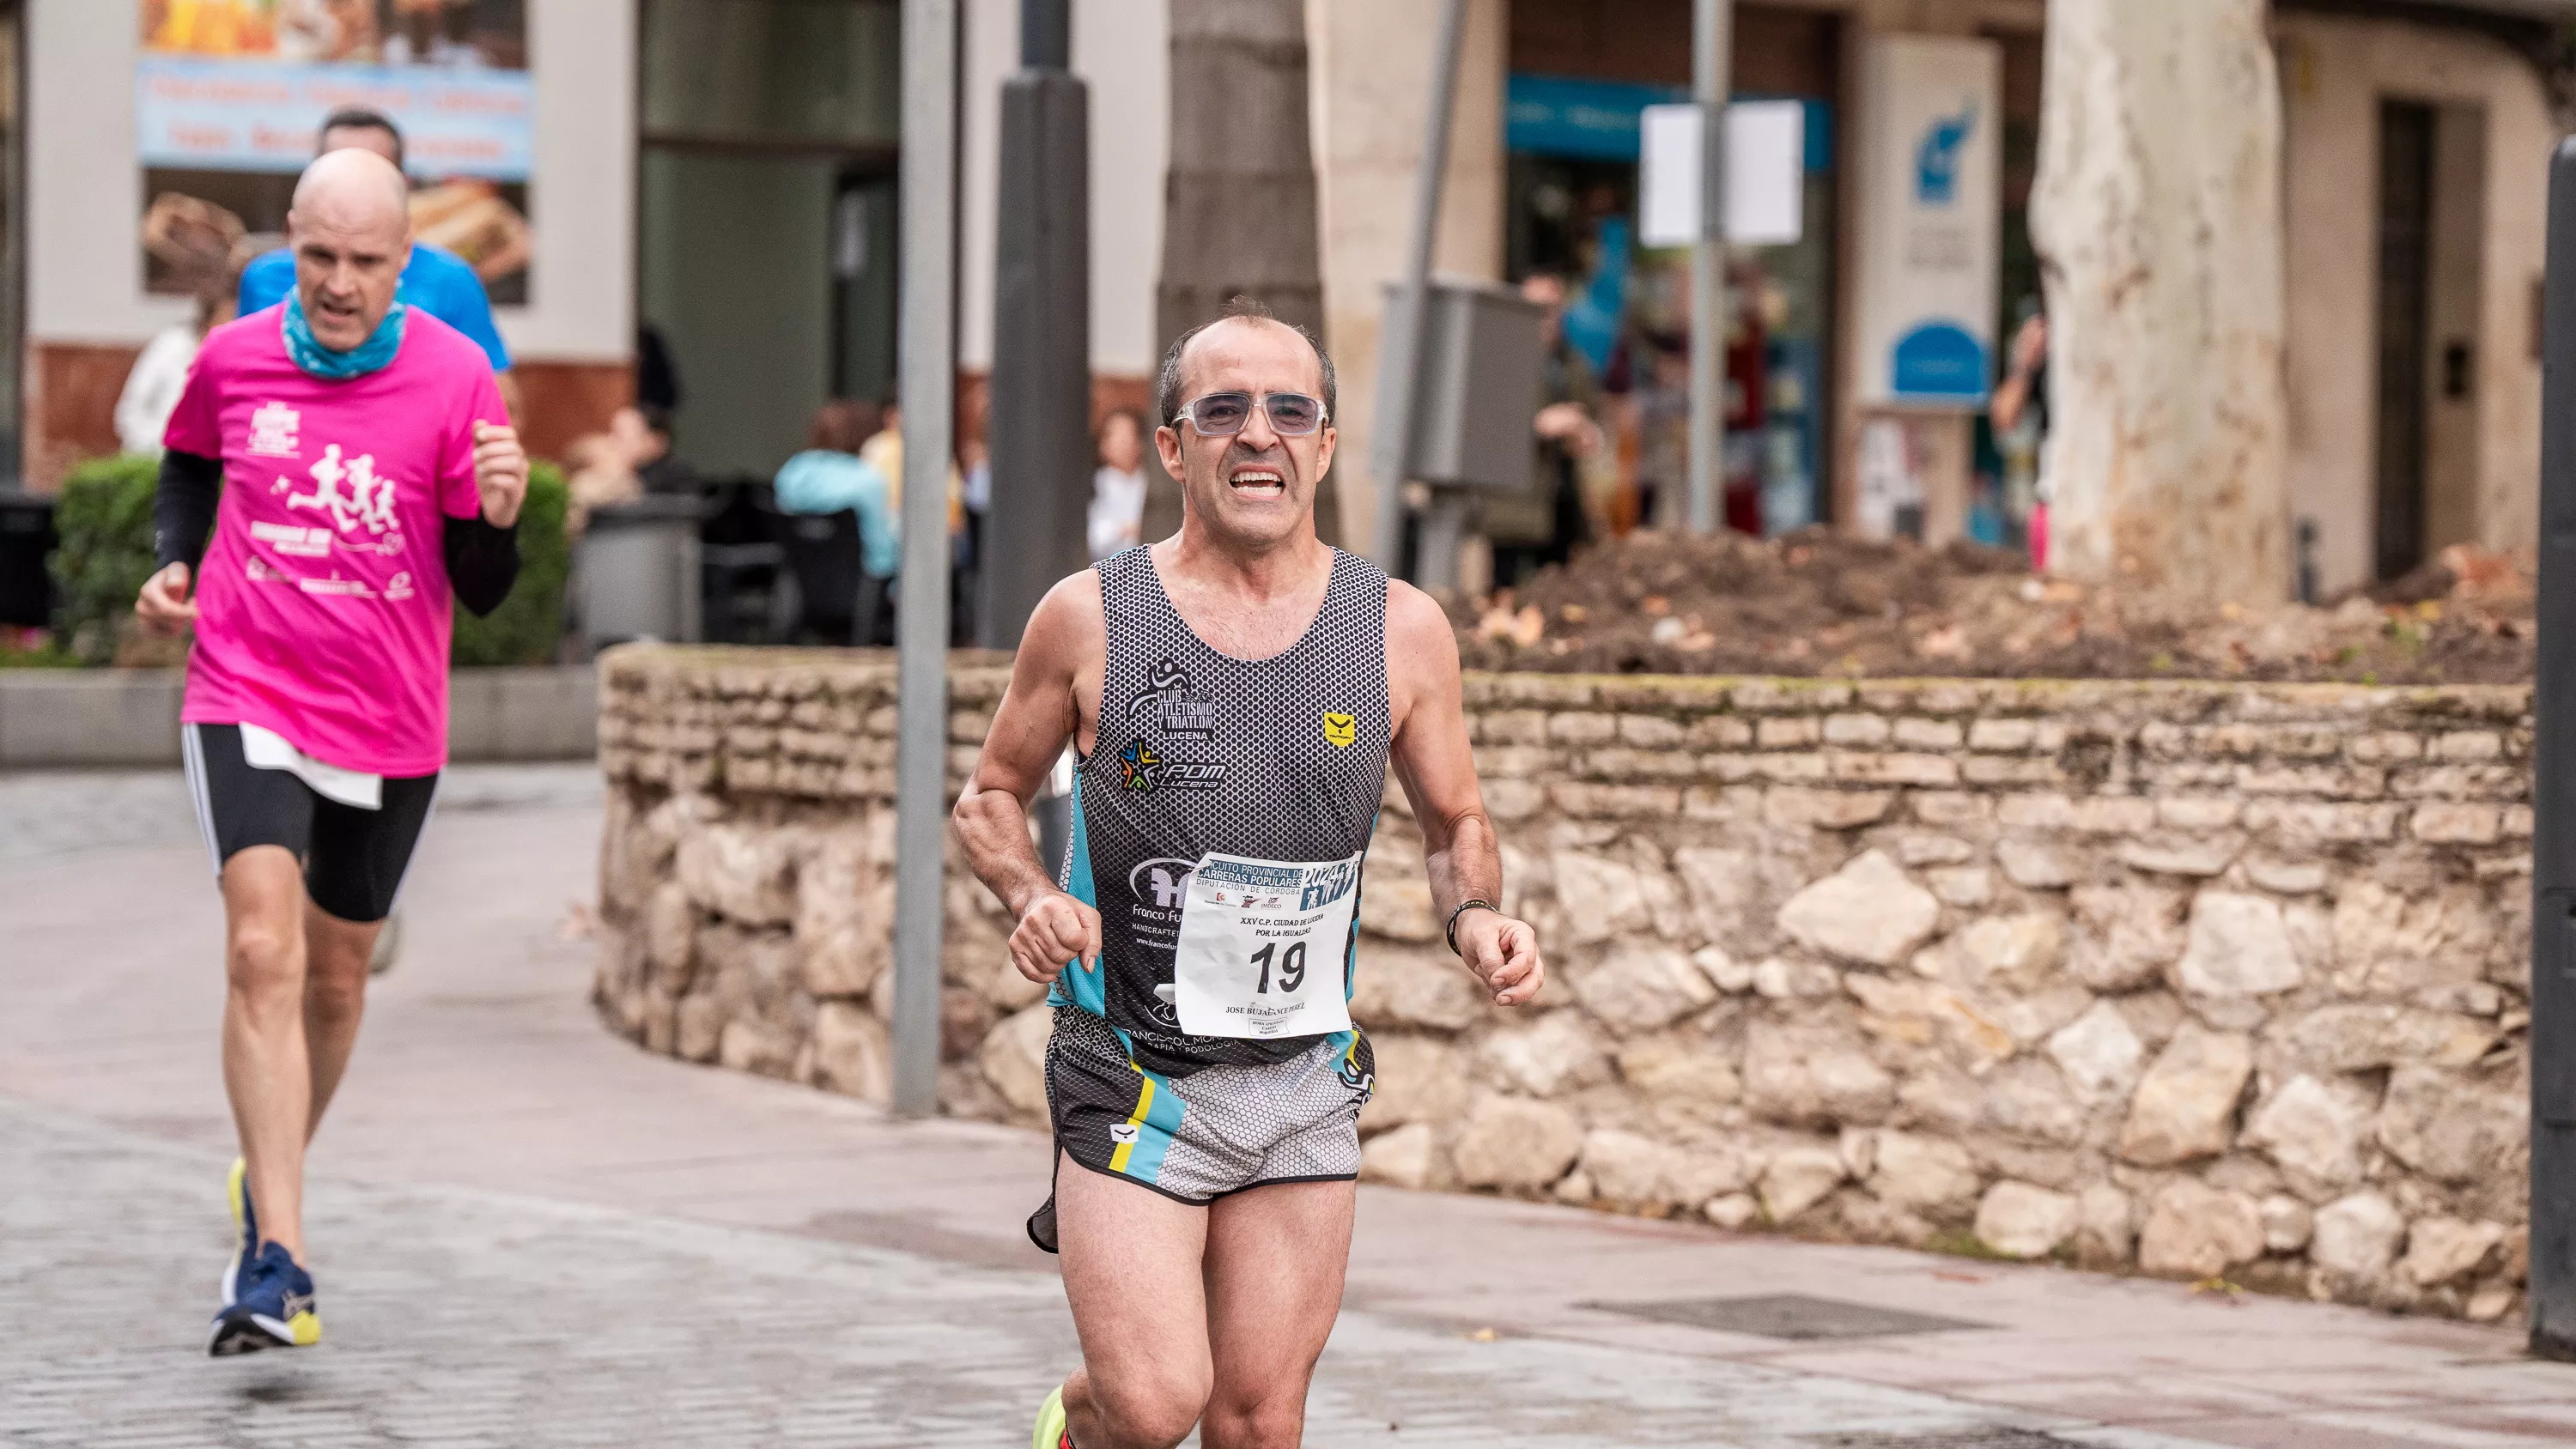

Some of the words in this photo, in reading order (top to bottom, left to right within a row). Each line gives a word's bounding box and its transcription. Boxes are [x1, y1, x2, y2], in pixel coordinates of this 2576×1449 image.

[1157, 689, 1182, 703] CLUB
[1157, 702, 1212, 716] ATLETISMO
[1166, 715, 1213, 729] TRIATLON
[1163, 731, 1208, 740] LUCENA
[1160, 778, 1218, 788] Lucena
[1207, 860, 1239, 873] CUITO
[1242, 864, 1291, 877] PROVINCIAL
[1293, 869, 1303, 878] DE
[1197, 869, 1248, 883] CARRERAS
[1251, 876, 1302, 888] POPULARES
[1303, 865, 1338, 888] 2024
[1240, 917, 1258, 925] XXV
[1249, 941, 1307, 994] 19
